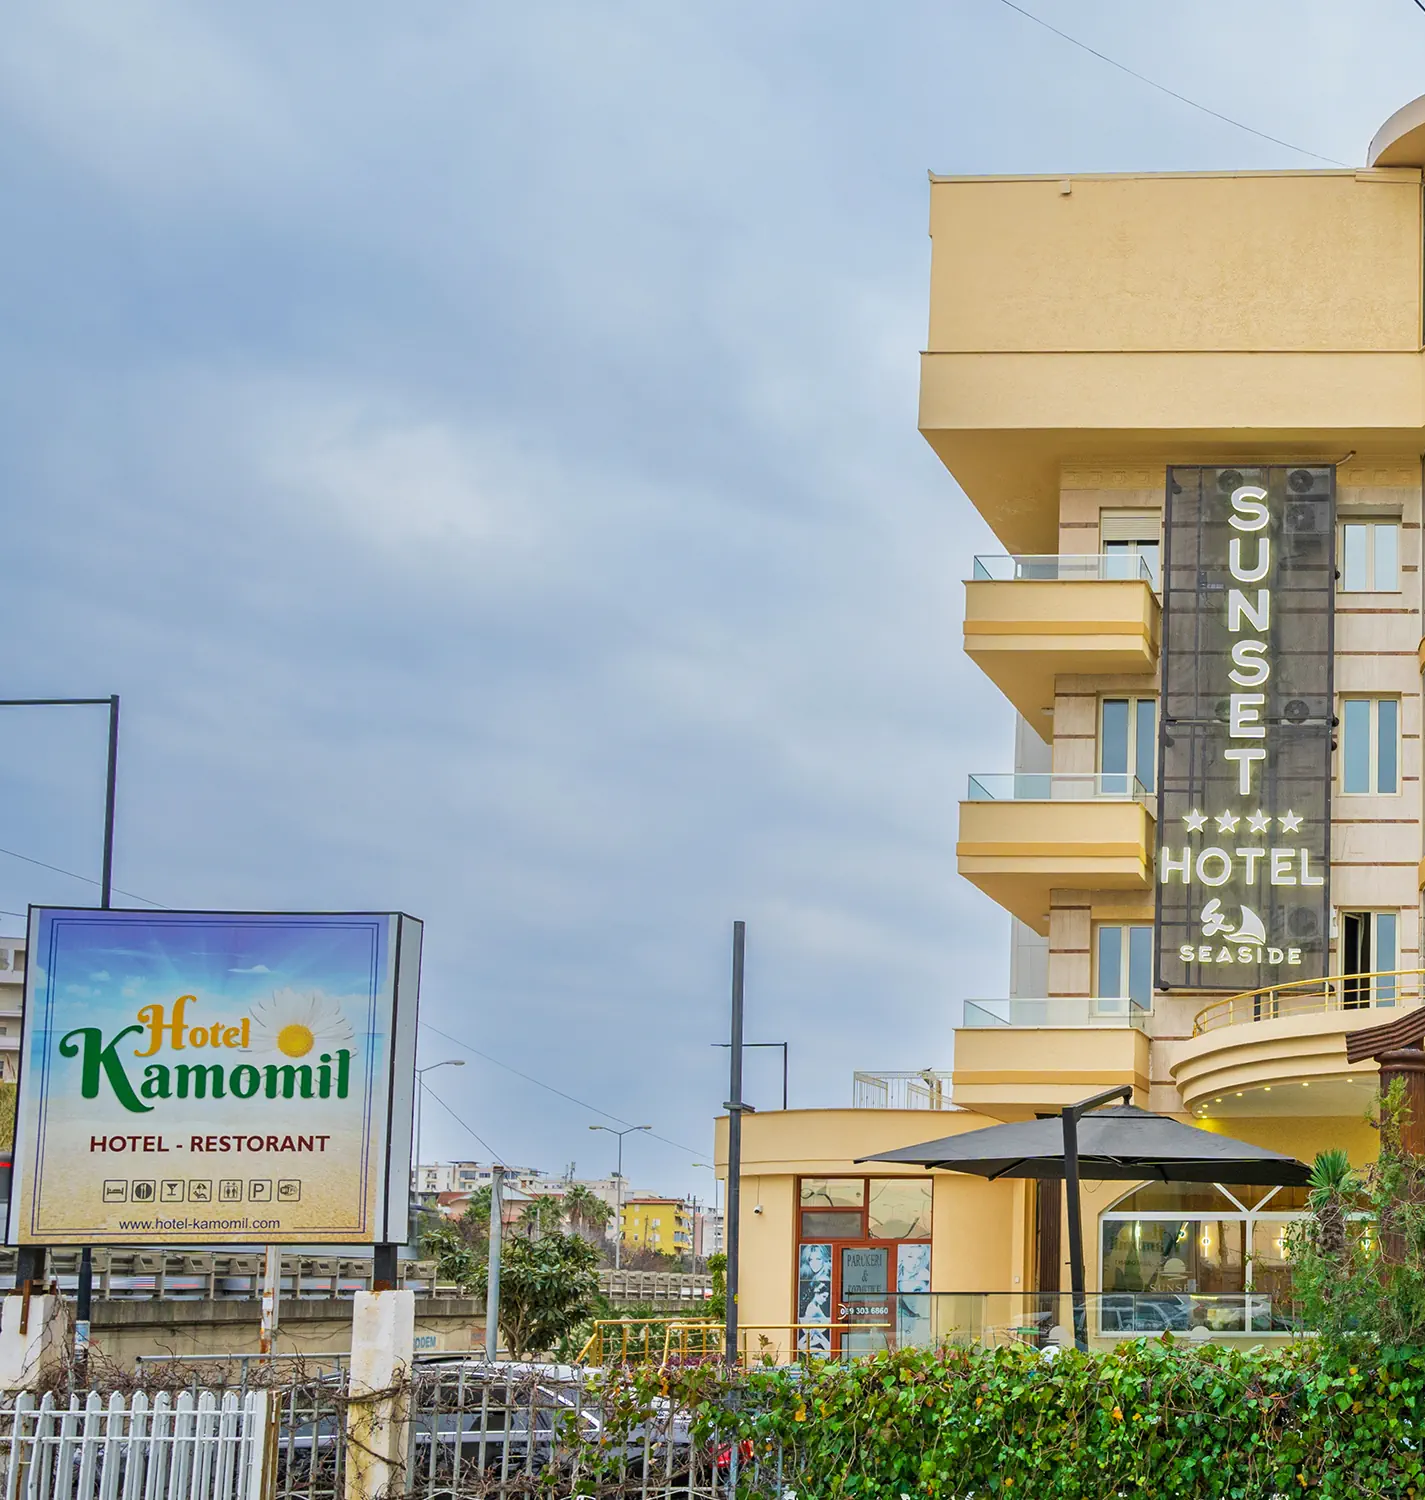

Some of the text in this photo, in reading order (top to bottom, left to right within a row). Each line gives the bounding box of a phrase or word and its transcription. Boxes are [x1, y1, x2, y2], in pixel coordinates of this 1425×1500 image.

[1224, 485, 1270, 796] SUNSET
[1160, 847, 1324, 886] HOTEL
[1179, 945, 1301, 964] SEASIDE
[134, 995, 251, 1057] Hotel
[59, 1024, 352, 1113] Kamomil
[90, 1136, 170, 1153] HOTEL
[189, 1135, 331, 1153] RESTORANT
[119, 1218, 281, 1230] www.hotel-kamomil.com
[1150, 1283, 1200, 1293] SUNSE
[856, 1307, 869, 1315] 303
